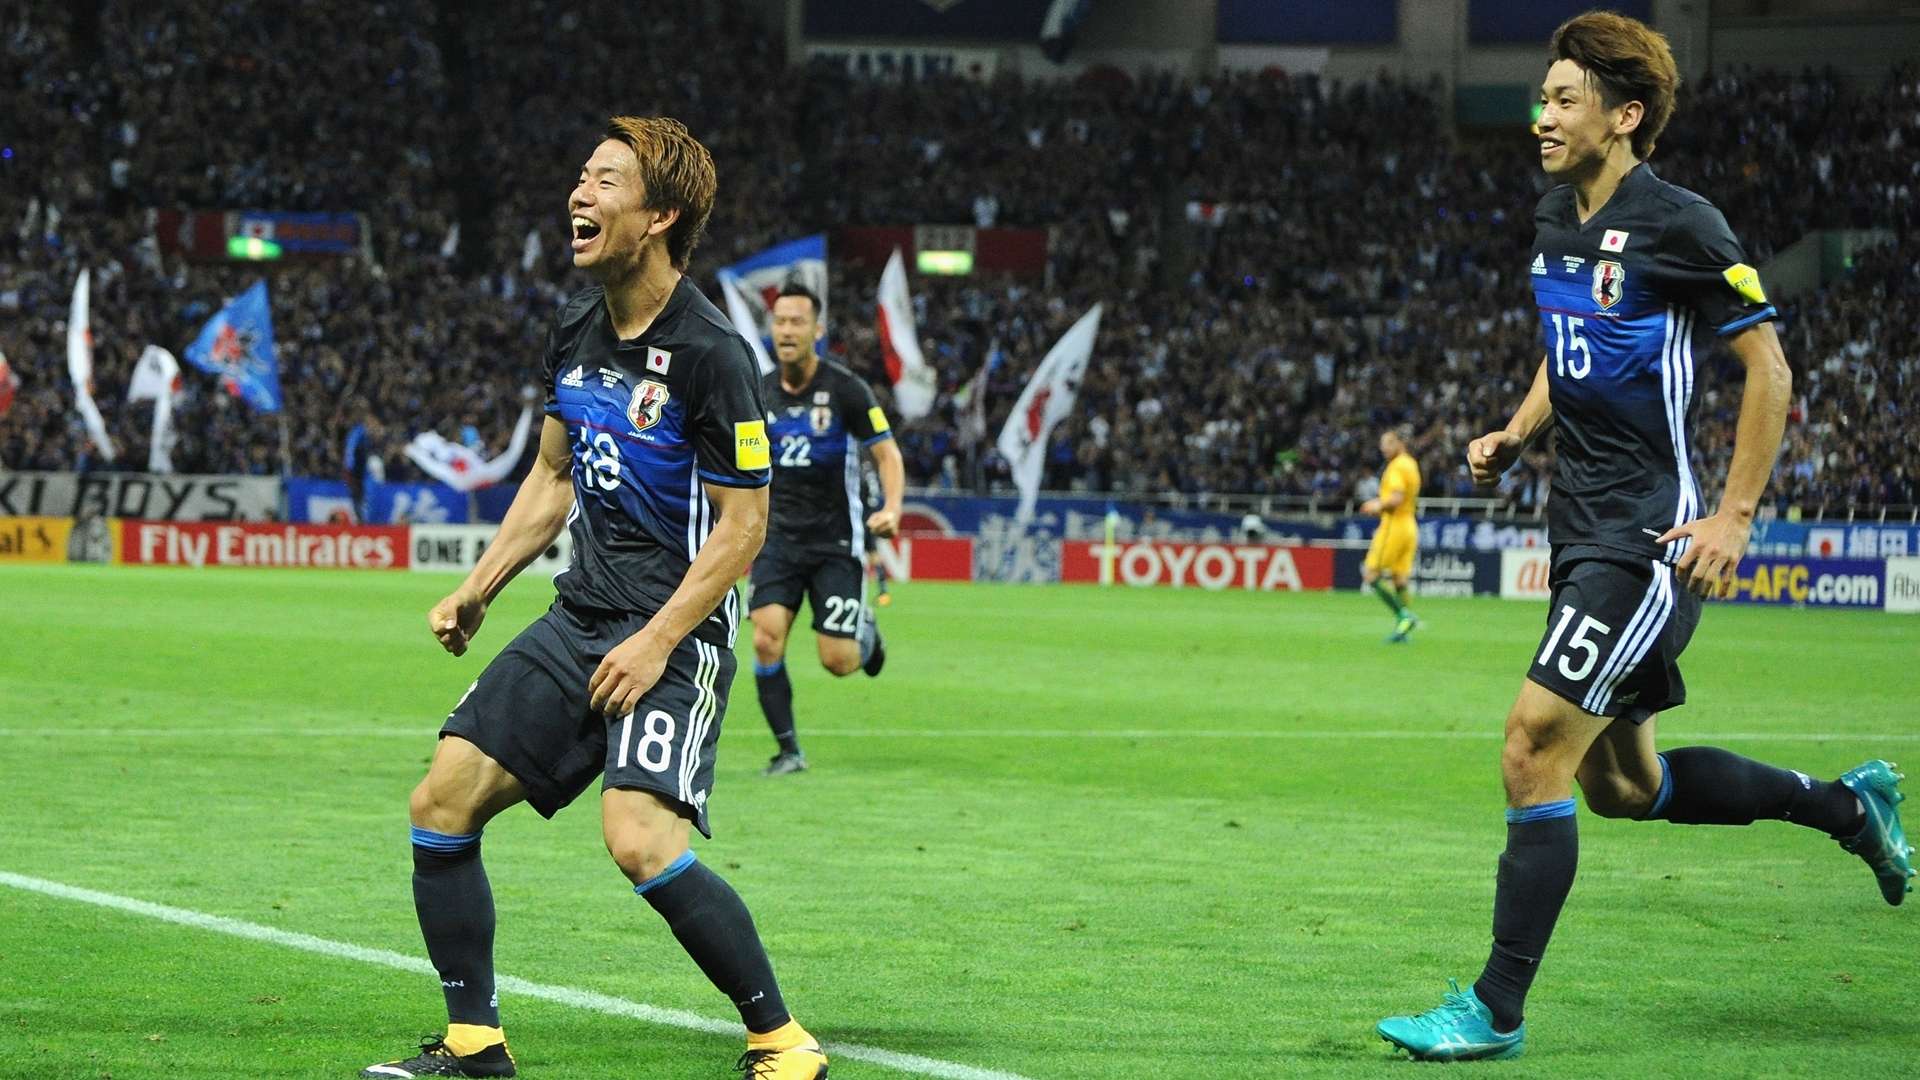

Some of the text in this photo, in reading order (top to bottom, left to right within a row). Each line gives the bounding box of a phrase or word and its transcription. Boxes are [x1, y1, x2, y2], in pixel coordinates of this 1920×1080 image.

[1552, 313, 1591, 380] 15
[627, 430, 655, 441] JAPAN
[740, 437, 761, 447] FIFA
[780, 435, 812, 467] 22
[580, 426, 621, 491] 18
[72, 477, 240, 522] BOYS
[140, 525, 394, 568] Fly Emirates
[416, 536, 464, 564] ONE
[1088, 544, 1303, 590] TOYOTA
[823, 595, 860, 633] 22
[1538, 604, 1611, 681] 15
[617, 710, 675, 773] 18
